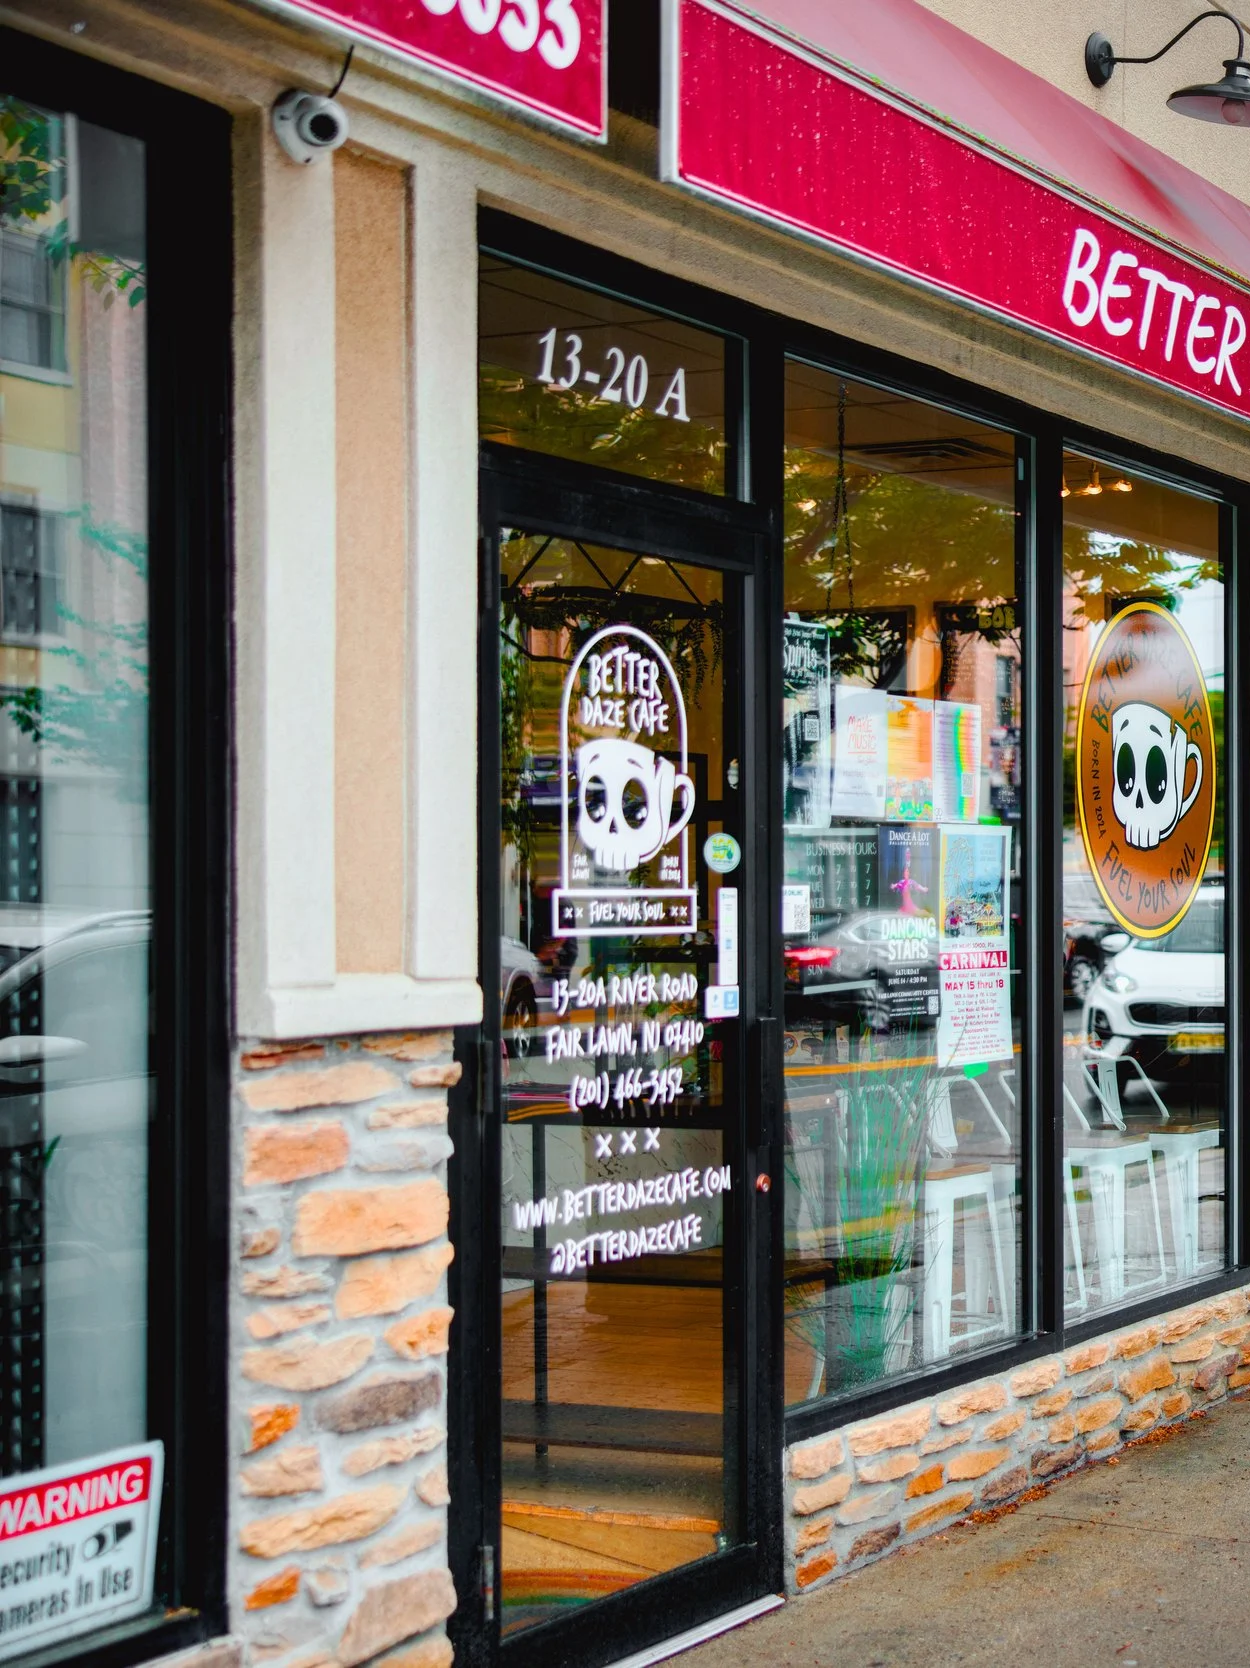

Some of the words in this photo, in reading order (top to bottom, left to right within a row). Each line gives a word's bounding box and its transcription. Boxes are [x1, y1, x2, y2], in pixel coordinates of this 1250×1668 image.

[1062, 228, 1247, 397] BETTER
[537, 327, 649, 409] 13-20
[655, 367, 691, 423] A
[588, 645, 663, 700] BETTER
[581, 695, 626, 729] DAZE
[628, 698, 669, 736] CAFE
[1091, 739, 1100, 779] BORN
[805, 842, 846, 857] BUSINESS
[848, 841, 877, 856] HOURS
[889, 830, 912, 842] DANCE
[918, 832, 930, 842] LOT
[807, 864, 825, 875] MON
[865, 863, 871, 874] 7
[866, 880, 871, 890] 7
[1102, 840, 1132, 900] FUEL
[1137, 880, 1170, 914] YOUR
[1170, 843, 1196, 892] SOUL
[589, 900, 615, 924] FUEL
[616, 901, 642, 922] YOUR
[641, 900, 666, 922] SOUL
[866, 895, 871, 906] 7
[881, 917, 937, 940] DANCING
[888, 938, 929, 961] STARS
[940, 951, 1007, 970] CARNIVAL
[807, 965, 823, 976] SUN
[895, 968, 920, 976] SATURDAY
[944, 981, 963, 991] MAY
[966, 981, 975, 990] 15
[977, 980, 993, 989] thru
[995, 979, 1004, 988] 18
[552, 976, 607, 1016] 13-20A
[609, 973, 659, 1006] RIVER
[661, 972, 698, 1004] ROAD
[546, 1024, 584, 1064] FAIR
[588, 1021, 637, 1056] LAWN,
[641, 1020, 661, 1052] NJ
[664, 1019, 704, 1054] 07410
[570, 1070, 610, 1112] (201)
[613, 1067, 684, 1110] 466-3452
[514, 1164, 732, 1230] WWW.BETTERDAZECAFE.COM
[550, 1213, 702, 1275] @BETTERDAZECAFE
[0, 1465, 144, 1536] WARNING
[76, 1574, 94, 1607] In
[100, 1565, 133, 1599] Use
